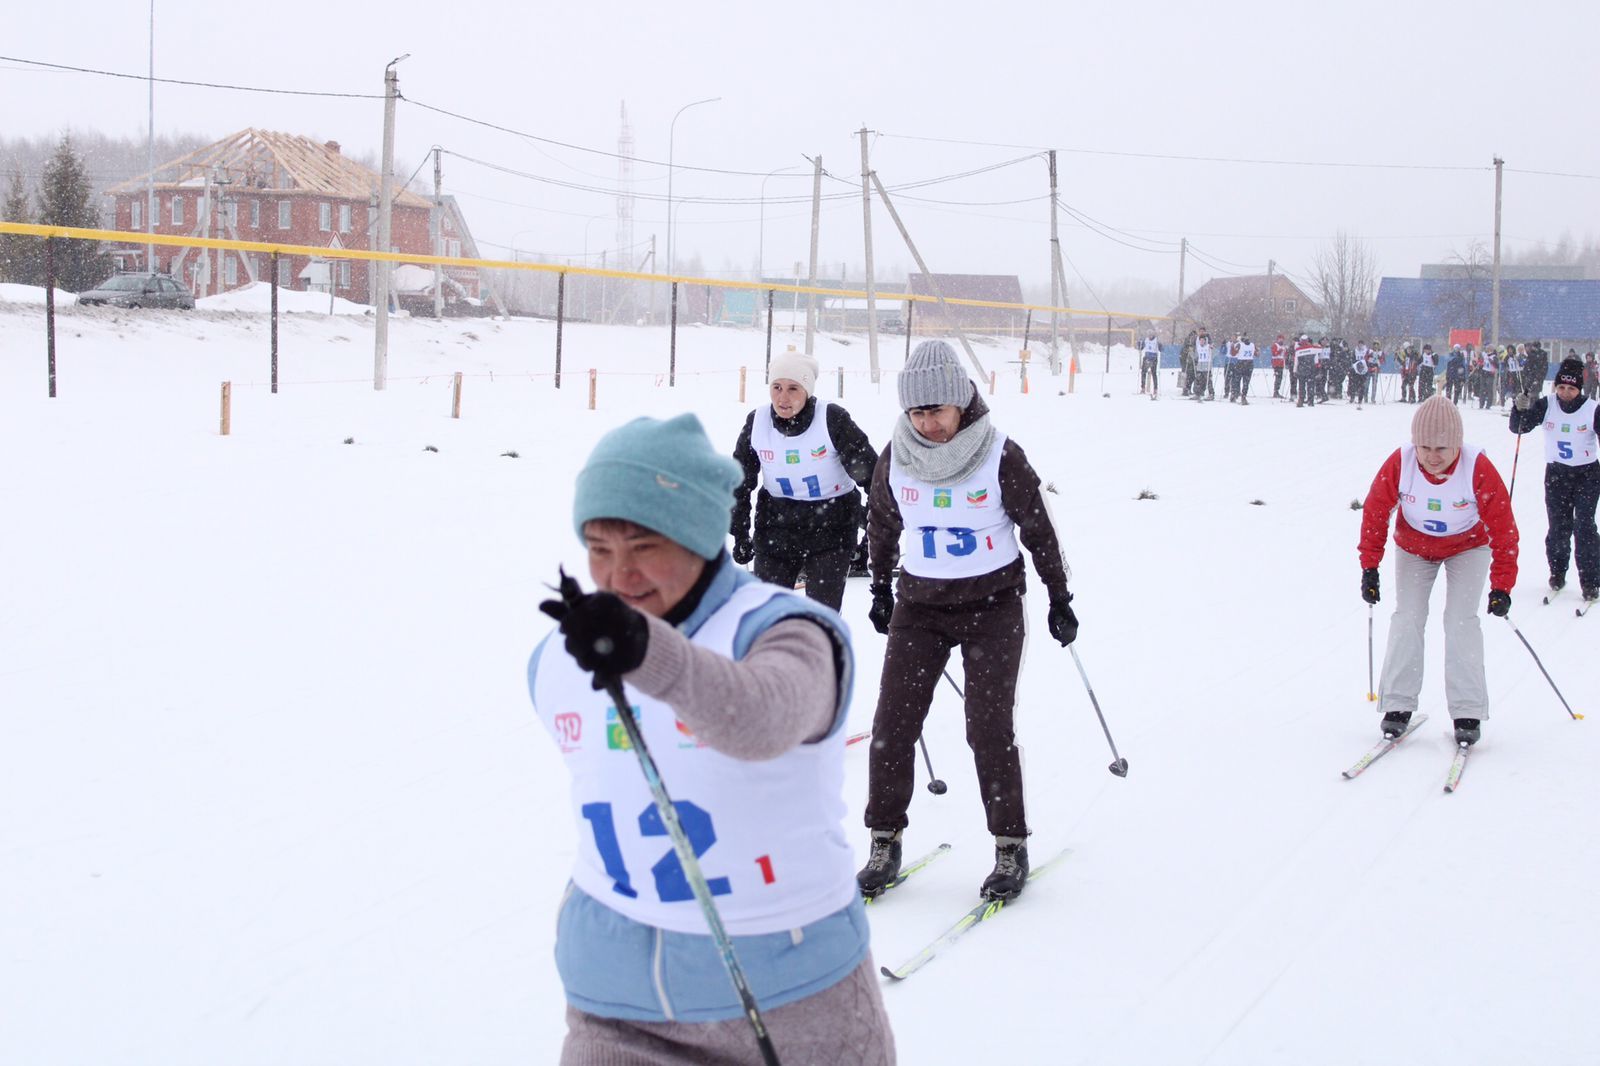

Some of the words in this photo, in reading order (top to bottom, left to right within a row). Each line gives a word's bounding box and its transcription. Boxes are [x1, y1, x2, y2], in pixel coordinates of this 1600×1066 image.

[760, 449, 774, 460] ГТО
[1557, 441, 1573, 459] 5
[775, 474, 822, 498] 11
[901, 486, 919, 502] ГТО
[919, 526, 978, 559] 13
[985, 535, 994, 551] 1
[554, 712, 582, 741] ГТО
[581, 800, 733, 903] 12
[755, 855, 776, 885] 1
